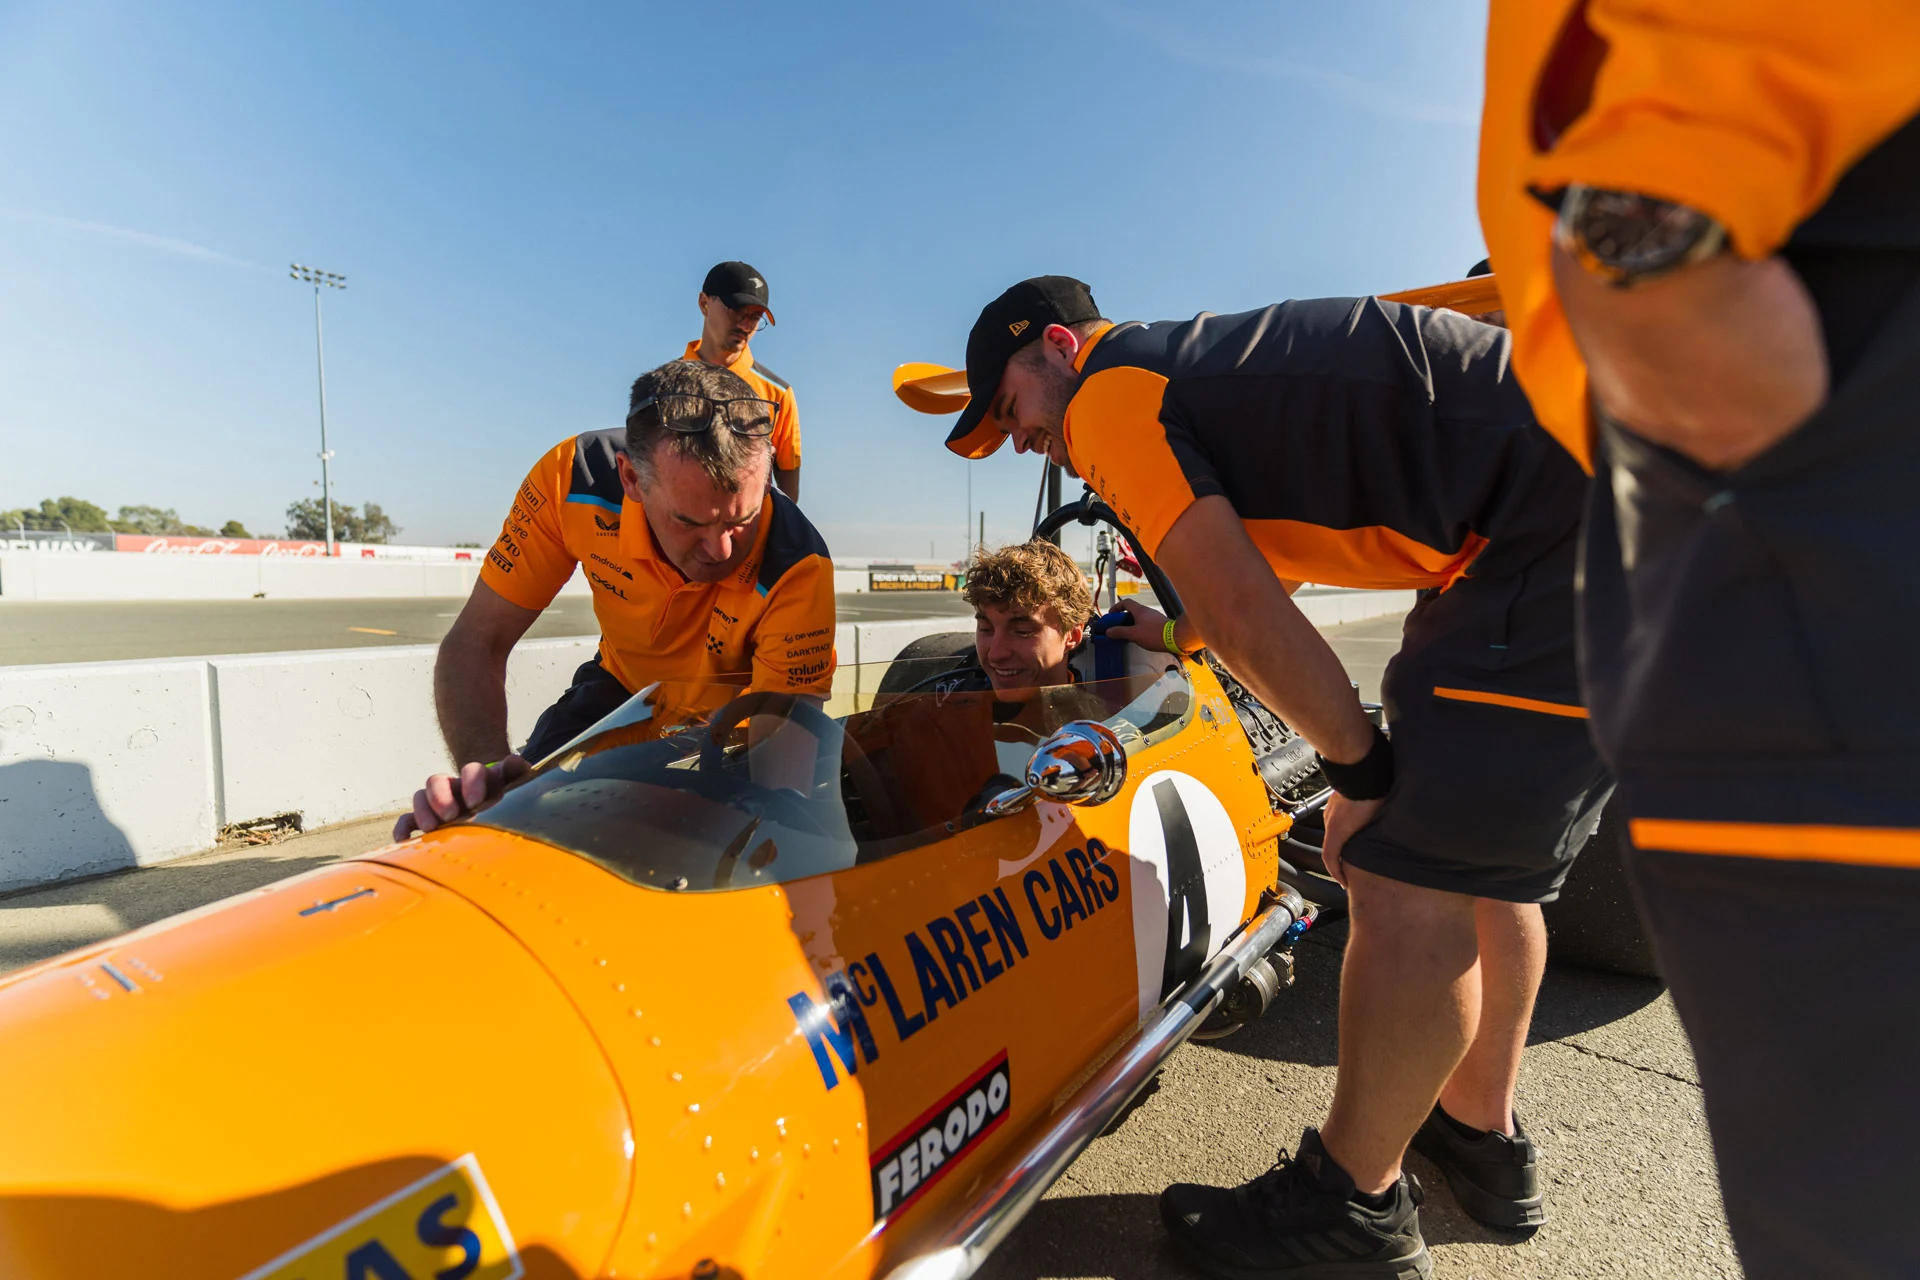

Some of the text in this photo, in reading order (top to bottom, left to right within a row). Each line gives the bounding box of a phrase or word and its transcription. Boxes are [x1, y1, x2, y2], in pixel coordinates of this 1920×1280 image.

[590, 553, 622, 573] android
[591, 572, 629, 601] DELL
[807, 628, 830, 639] WORLD
[787, 643, 831, 659] DARKTRACE
[1023, 838, 1120, 941] CARS
[878, 1071, 1009, 1215] FERODO
